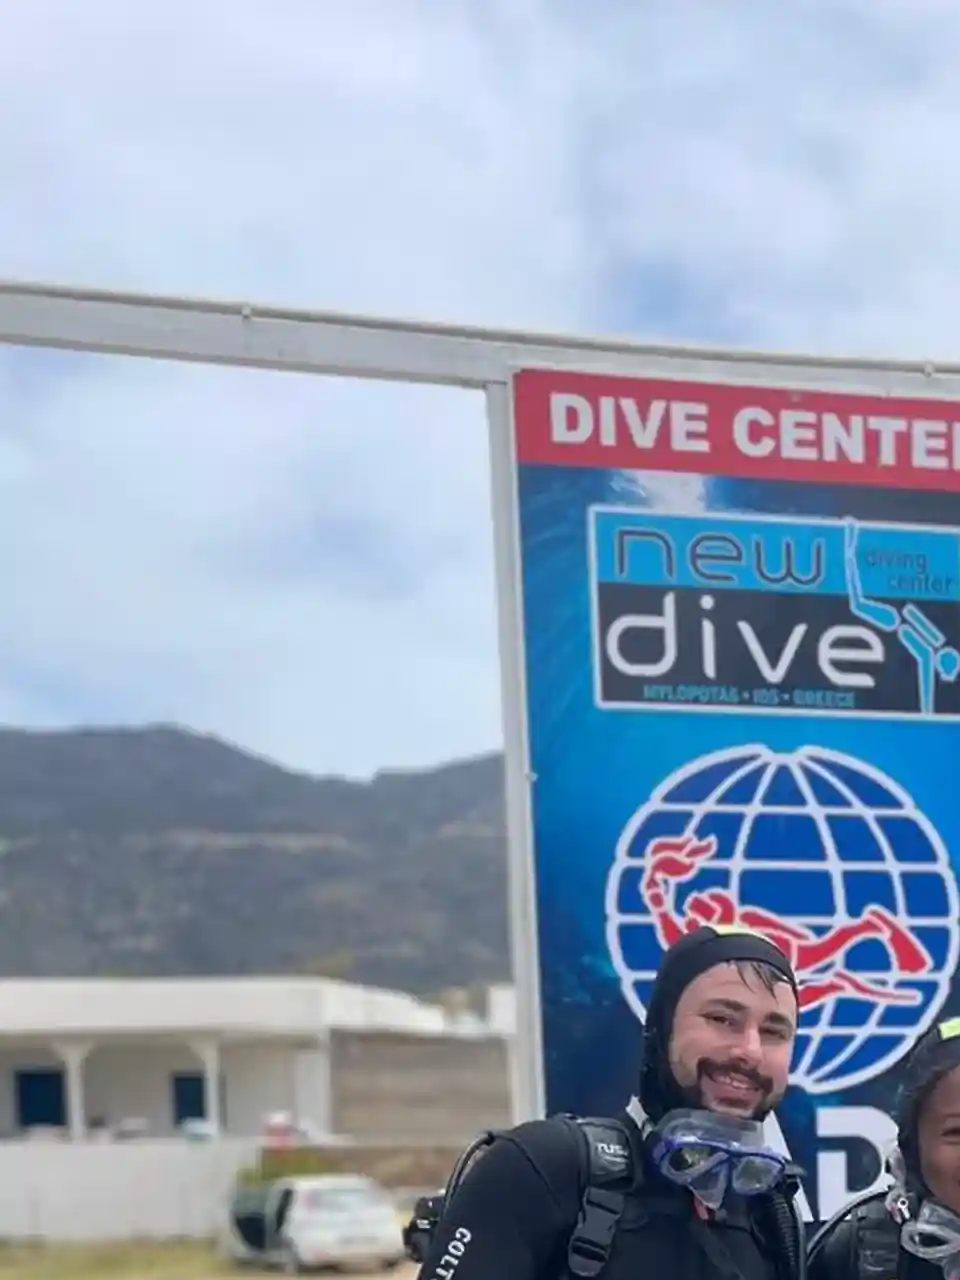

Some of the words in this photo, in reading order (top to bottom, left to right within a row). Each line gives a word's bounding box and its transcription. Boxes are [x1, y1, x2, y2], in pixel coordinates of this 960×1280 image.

[549, 391, 711, 453] DIVE
[613, 524, 826, 587] new
[864, 546, 928, 574] diving
[887, 573, 954, 595] center
[605, 590, 885, 688] dive
